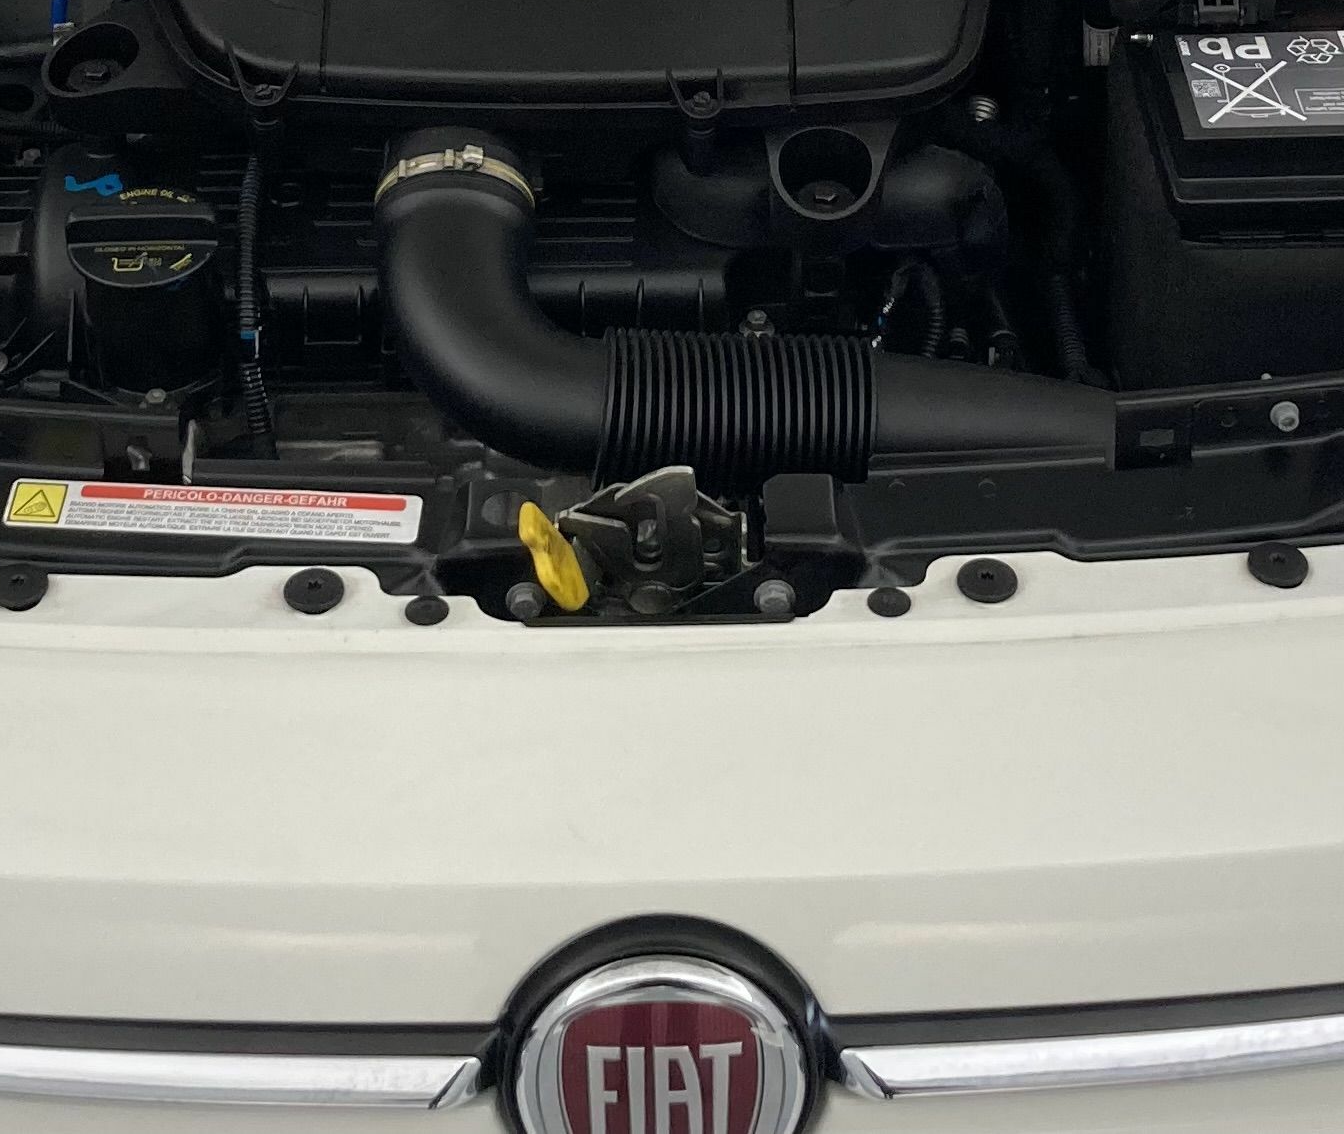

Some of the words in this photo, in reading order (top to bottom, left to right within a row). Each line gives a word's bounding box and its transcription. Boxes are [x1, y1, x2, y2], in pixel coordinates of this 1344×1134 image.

[1197, 36, 1272, 60] Pb
[119, 188, 158, 200] ENGINE
[143, 489, 348, 507] PERICOLO-DANGER-GEFAHR
[586, 1041, 744, 1134] FIAT
